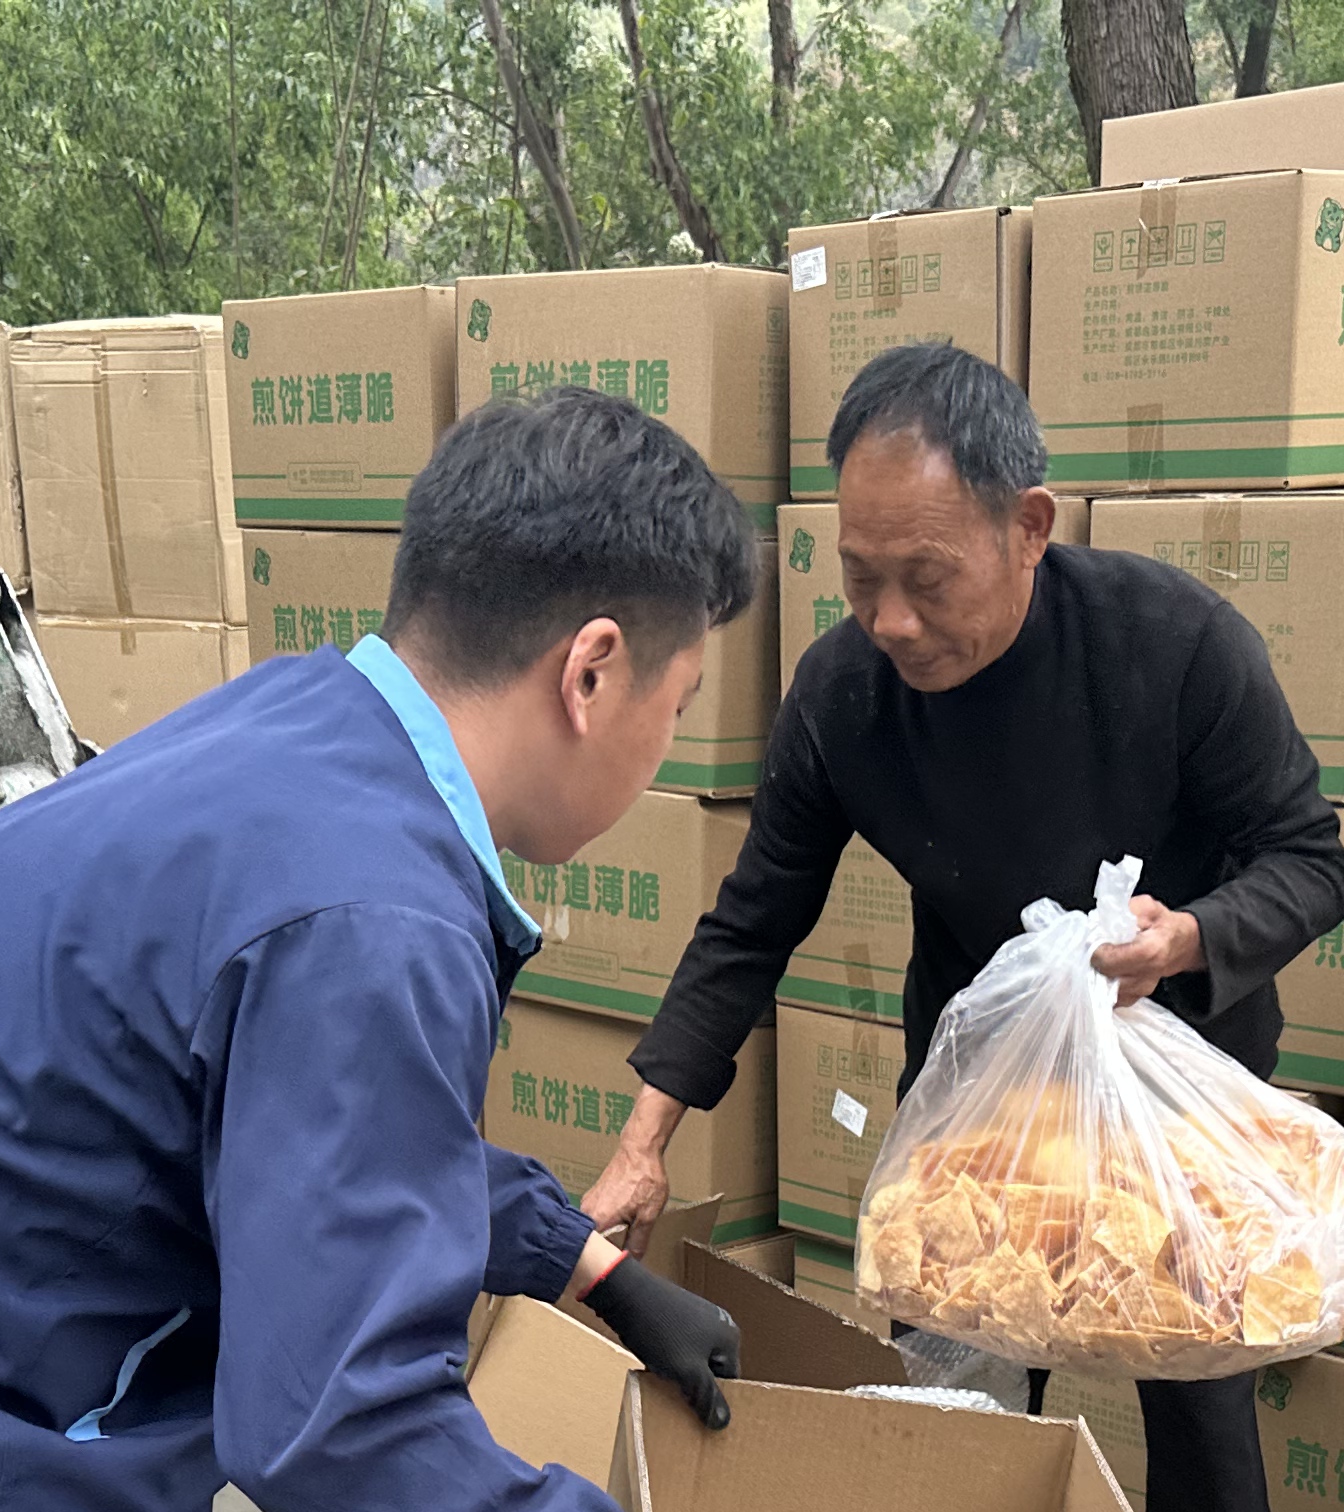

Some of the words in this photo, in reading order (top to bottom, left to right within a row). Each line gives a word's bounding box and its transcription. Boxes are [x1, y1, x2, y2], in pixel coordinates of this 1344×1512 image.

[251, 372, 394, 426] 煎饼道薄脆
